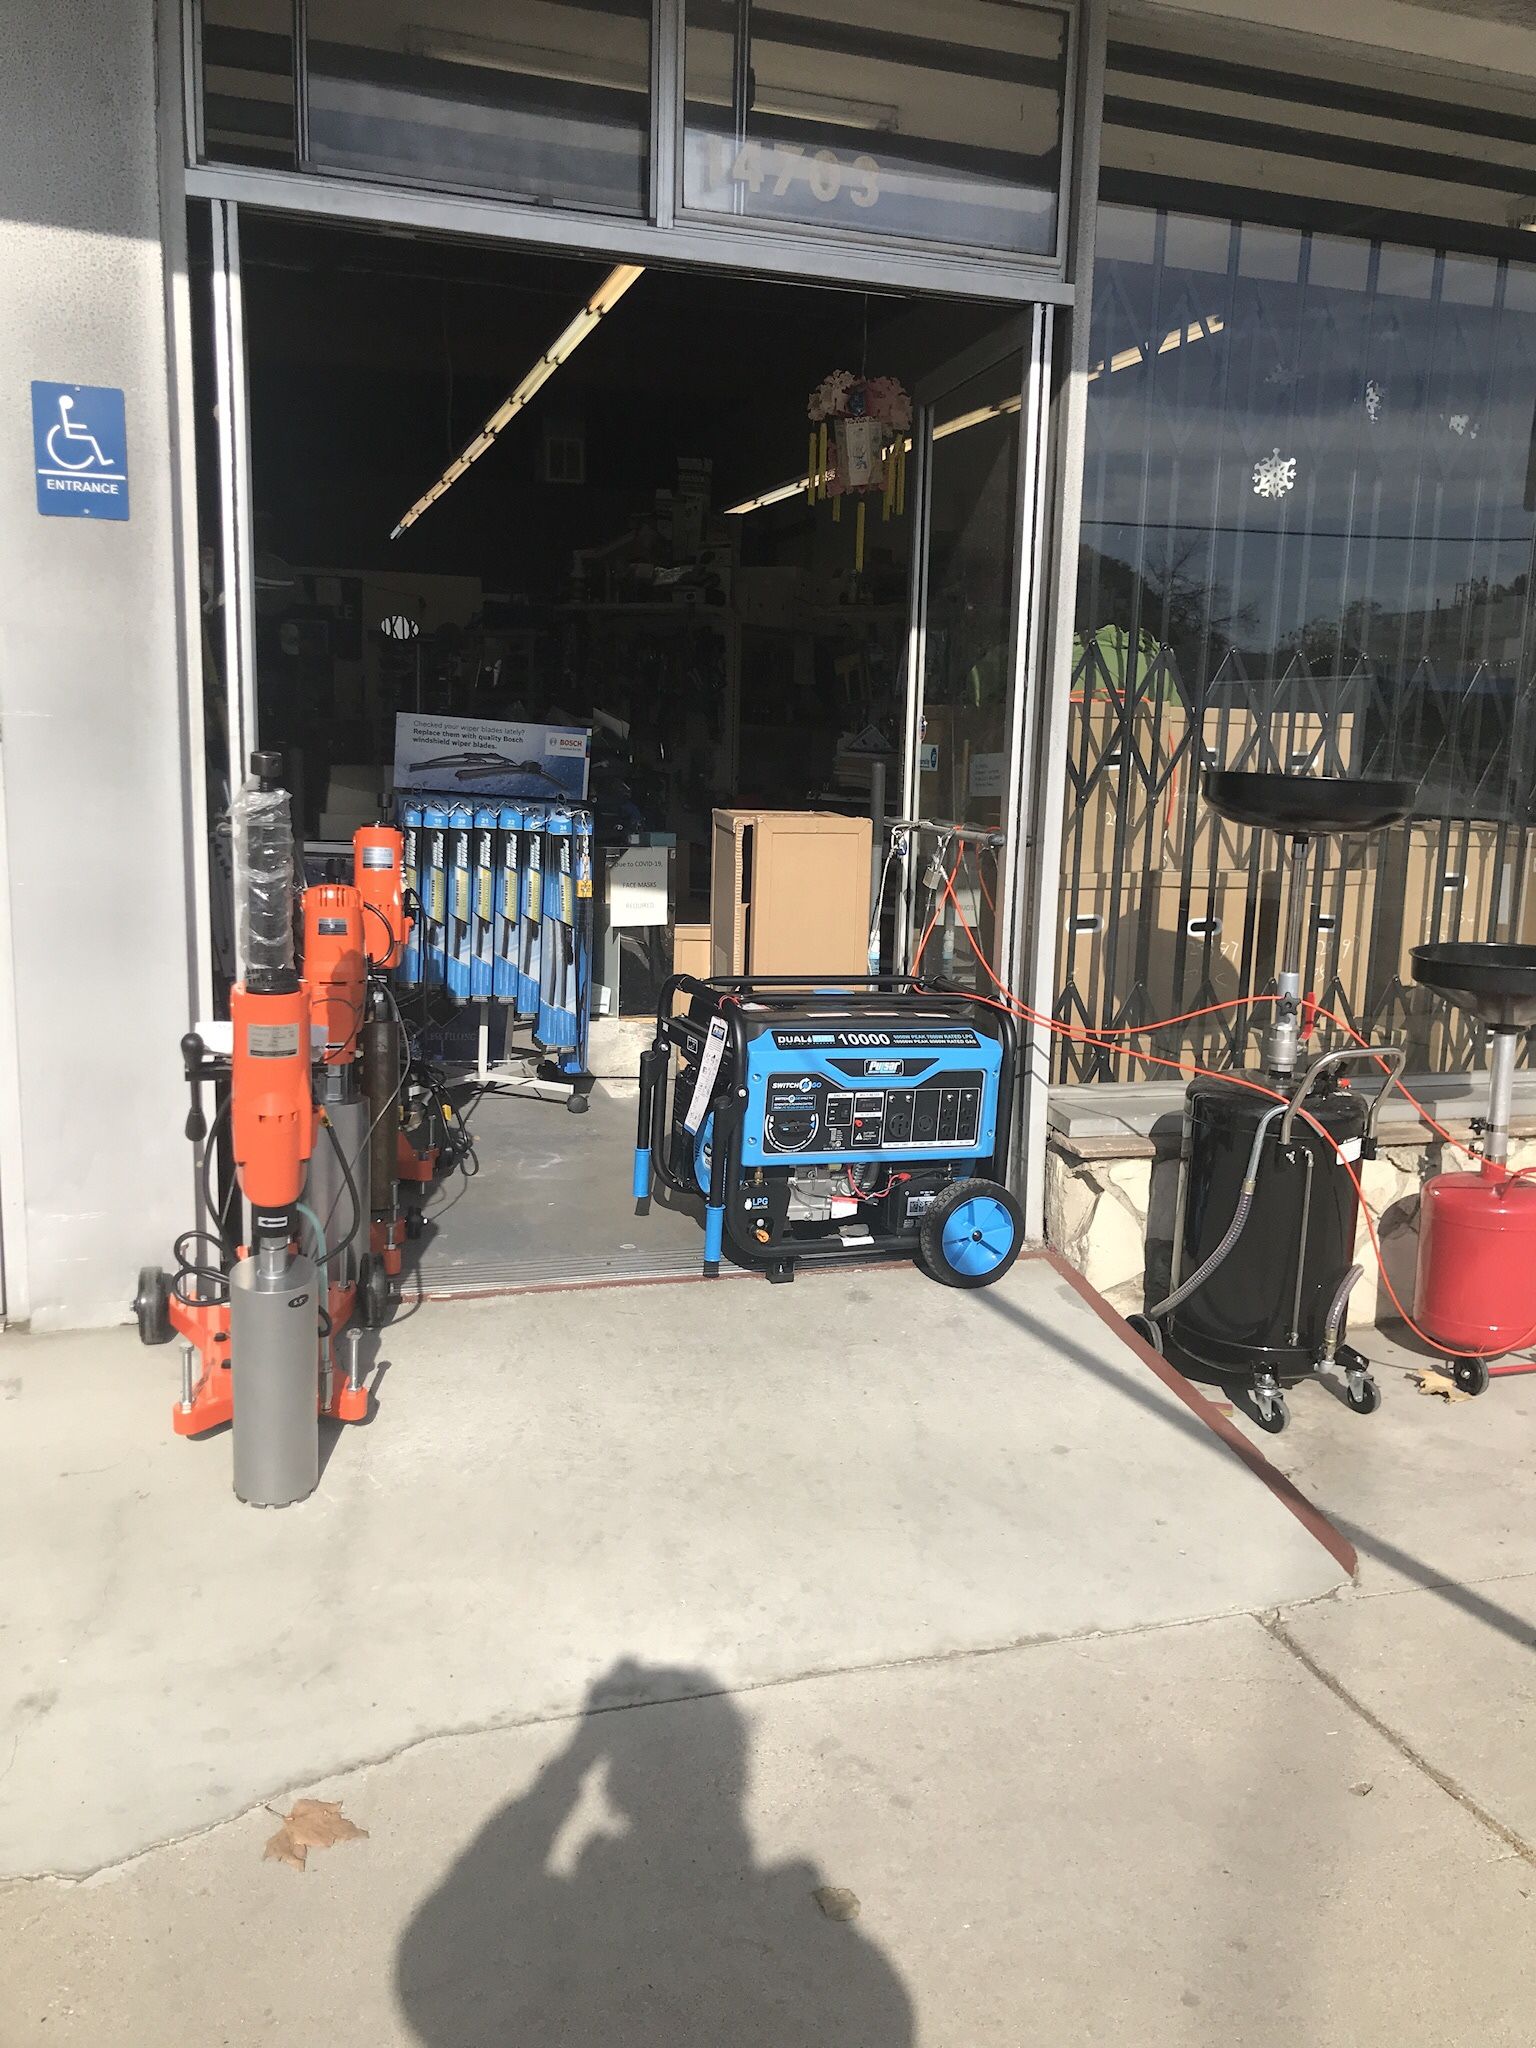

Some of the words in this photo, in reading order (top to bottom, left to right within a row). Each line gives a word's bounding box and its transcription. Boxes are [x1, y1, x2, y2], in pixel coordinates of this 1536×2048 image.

[46, 479, 119, 495] ENTRANCE
[413, 719, 443, 730] Checked
[443, 723, 460, 732] your
[460, 724, 480, 735] wiper
[481, 725, 503, 735] blades
[504, 728, 526, 738] lately?
[412, 735, 451, 747] windshield
[451, 739, 472, 749] wiper
[472, 740, 498, 750] blades.
[413, 728, 441, 740] Replace
[442, 731, 461, 739] them
[462, 731, 477, 741] with
[478, 732, 502, 744] quality
[503, 735, 524, 744] Bosch
[559, 738, 584, 748] BOSCH
[837, 1033, 891, 1046] 10000
[869, 1061, 901, 1071] Pulsar
[752, 1197, 769, 1206] LPG
